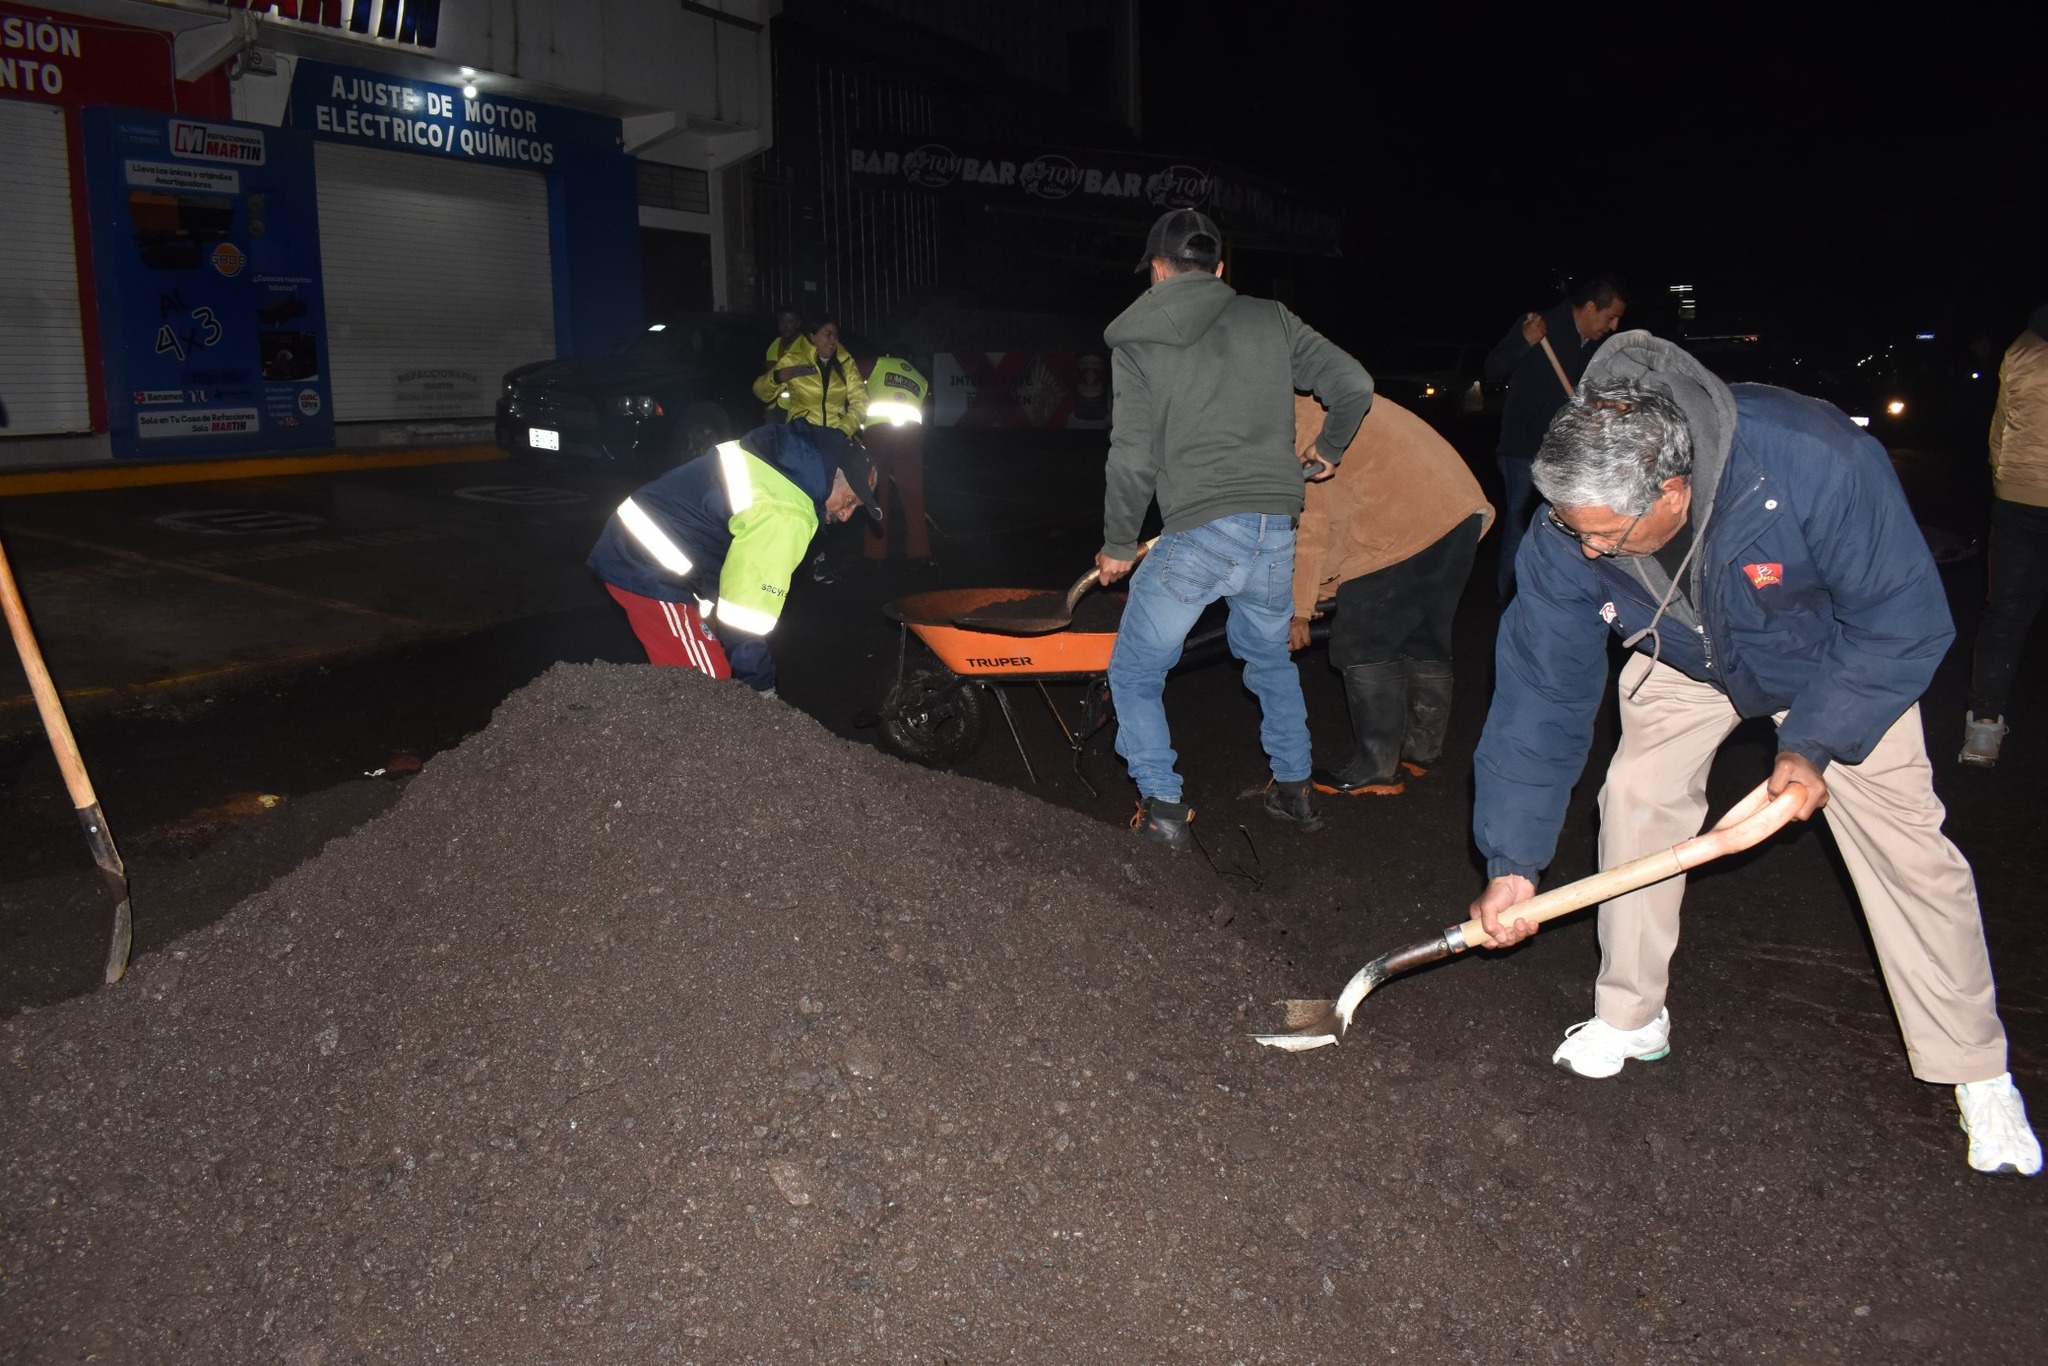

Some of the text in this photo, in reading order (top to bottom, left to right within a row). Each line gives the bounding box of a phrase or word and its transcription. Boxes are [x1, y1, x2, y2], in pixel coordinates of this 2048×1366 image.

[0, 16, 82, 58] SIÓN
[331, 75, 537, 133] AJUSTE DE MOTOR
[206, 141, 262, 161] MARTIN
[851, 149, 900, 175] BAR
[961, 158, 1017, 185] BAR
[1083, 168, 1143, 198] BAR
[147, 393, 182, 401] Banamex
[211, 413, 255, 421] Refacciones
[211, 422, 247, 432] MARTIN
[965, 656, 1034, 668] TRUPER
